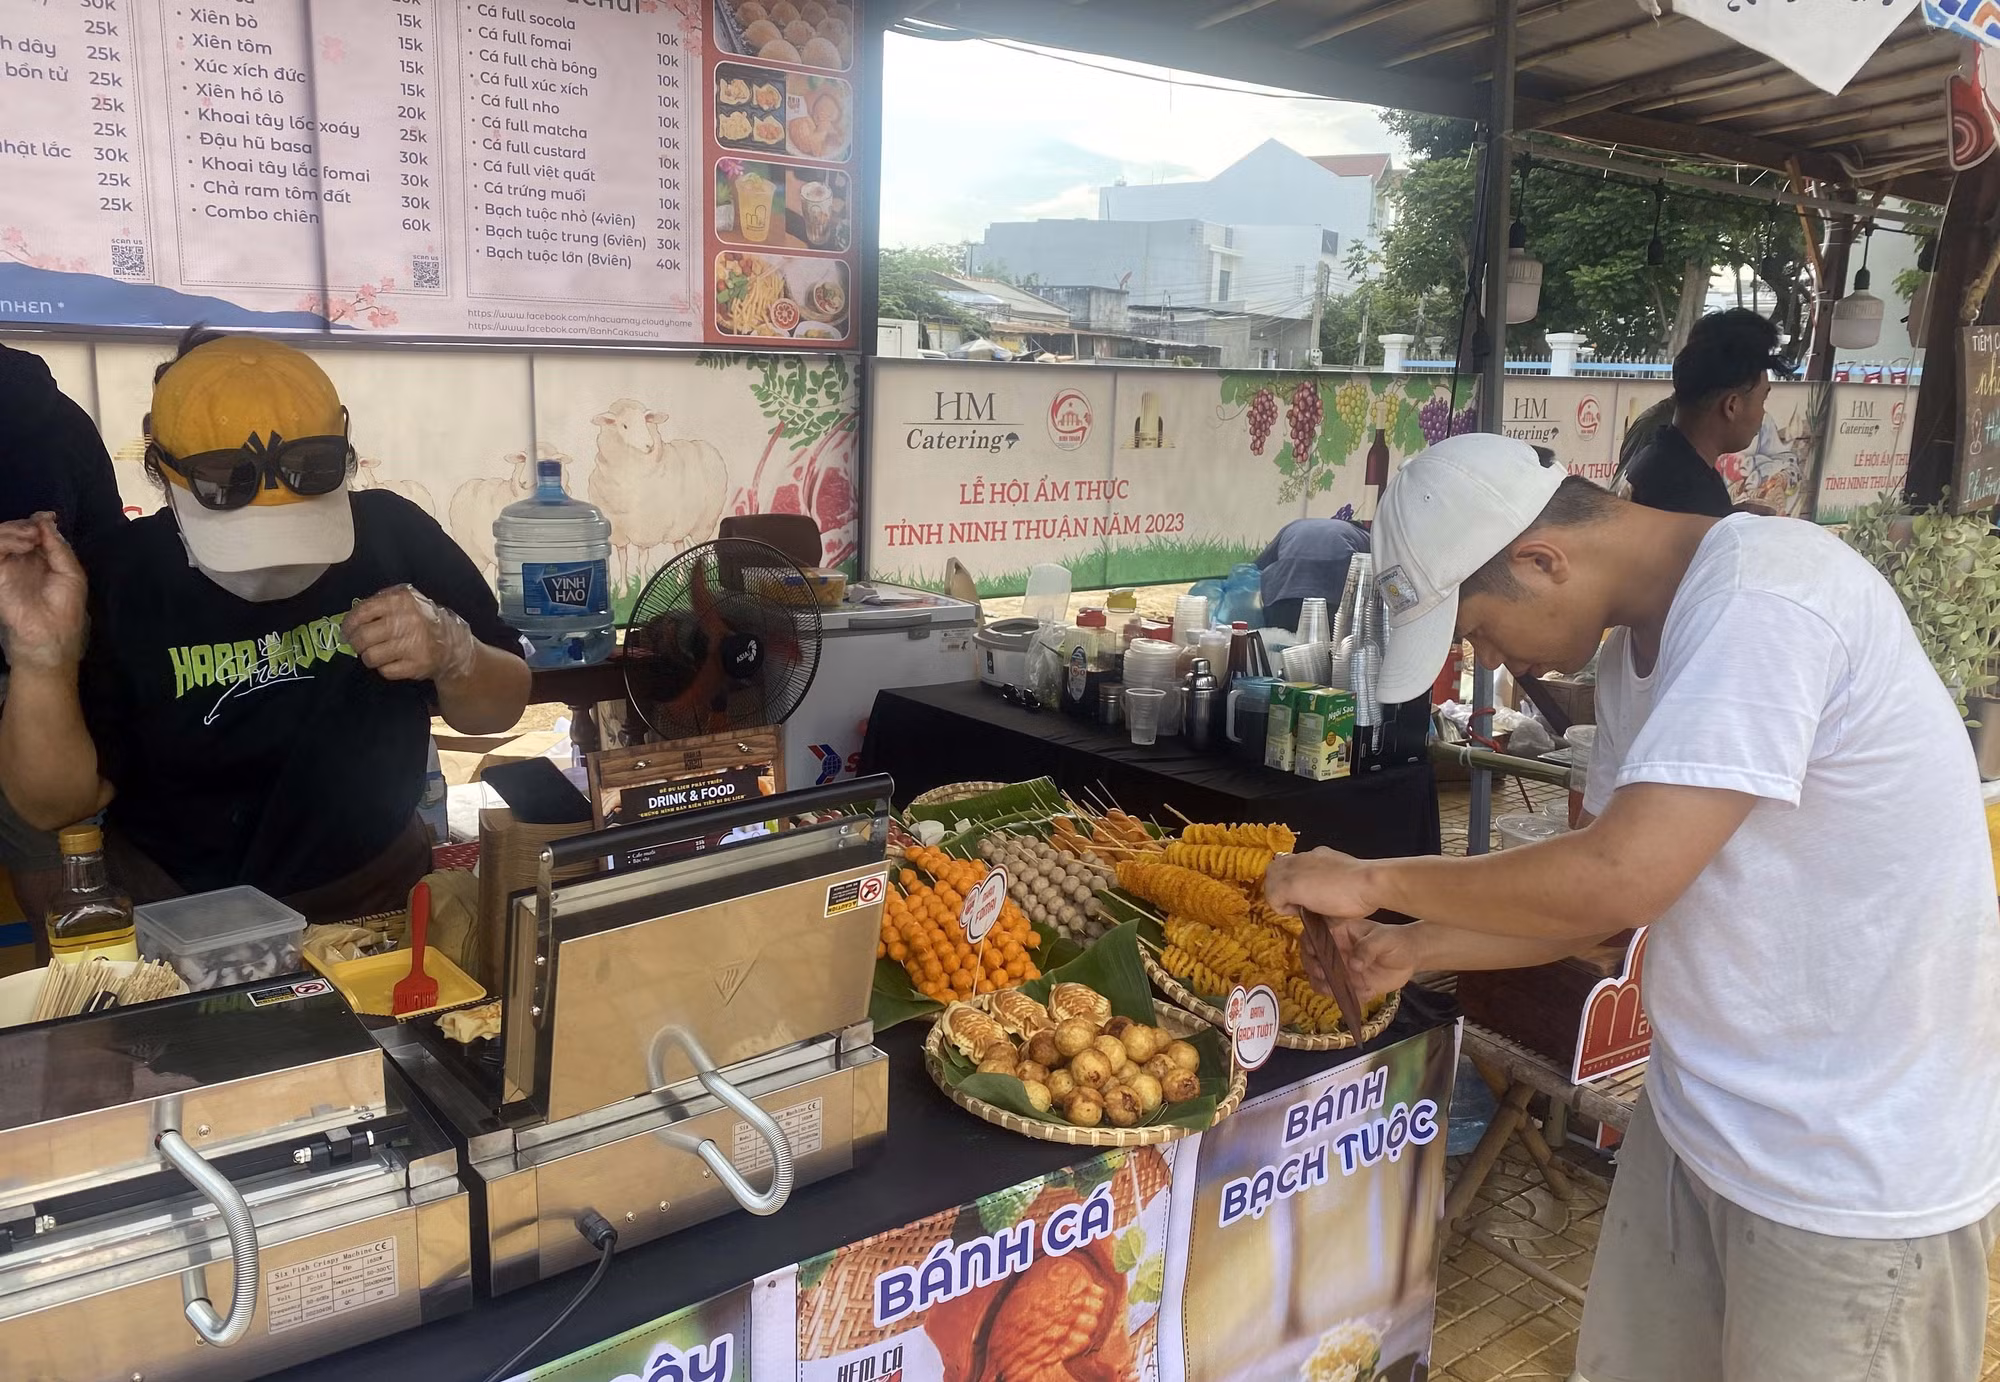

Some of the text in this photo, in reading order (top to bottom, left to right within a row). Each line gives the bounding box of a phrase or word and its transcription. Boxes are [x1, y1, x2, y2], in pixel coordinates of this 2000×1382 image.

[190, 8, 258, 29] Xiên bò
[397, 13, 422, 29] 15k
[477, 3, 575, 30] Cá full socola
[84, 20, 118, 36] 25k
[192, 33, 272, 55] Xiên tôm
[398, 36, 423, 52] 15k
[478, 26, 571, 51] Cá full fomai
[657, 32, 678, 47] 10k
[18, 38, 56, 58] dây
[87, 46, 120, 62] 25k
[399, 60, 425, 75] 15k
[479, 49, 597, 79] Cá full chà bông
[657, 53, 679, 68] 10k
[6, 62, 69, 82] bồn tử
[89, 71, 123, 87] 25k
[194, 57, 306, 83] Xúc xích đức
[401, 83, 426, 98] 15k
[480, 71, 588, 96] Cá full xúc xích
[658, 74, 679, 89] 10k
[196, 82, 284, 104] Xiên hồ lô
[658, 95, 679, 109] 10k
[91, 97, 125, 113] 25k
[397, 105, 427, 121] 20k
[481, 93, 560, 115] Cá full nho
[93, 122, 127, 138] 25k
[198, 107, 360, 139] Khoai tây lốc xoáy
[482, 116, 587, 139] Cá full matcha
[658, 116, 679, 130] 10k
[200, 132, 312, 154] Đậu hũ basa
[400, 128, 428, 143] 25k
[658, 137, 680, 150] 10k
[42, 141, 72, 159] lắc
[94, 147, 129, 163] 30k
[483, 137, 586, 159] Cá full custard
[399, 151, 429, 166] 30k
[659, 157, 680, 170] 10k
[202, 156, 370, 183] Khoai tây lắc fomai
[483, 159, 595, 182] Cá full việt quất
[98, 172, 131, 188] 25k
[400, 173, 430, 188] 30k
[659, 177, 680, 191] 10k
[203, 180, 351, 204] Chả ram tôm đất
[484, 181, 586, 202] Cá trứng muối
[100, 197, 133, 212] 25k
[401, 196, 431, 210] 30k
[659, 198, 680, 211] 10k
[205, 204, 320, 224] Combo chiên
[485, 203, 635, 230] Bạch tuộc nhỏ (4viên)
[402, 218, 431, 232] 60k
[656, 219, 680, 231] 20k
[486, 224, 646, 251] Bạch tuộc trung (6viên)
[657, 238, 680, 251] 30k
[486, 246, 632, 270] Bạch tuộc lớn (8viên)
[656, 258, 681, 271] 40k
[934, 392, 997, 421] HM
[1513, 398, 1547, 419] HM
[1851, 400, 1874, 418] HM
[1840, 421, 1875, 437] Catering
[906, 428, 1004, 453] Catering
[959, 474, 1129, 507] LỄ HỘI ẨM THỰC
[1847, 477, 1868, 490] NINH
[884, 513, 1184, 546] TỈNH NINH THUẬN NĂM 2023
[168, 640, 258, 699] HARD
[1342, 705, 1354, 715] Sao
[648, 784, 735, 809] DRINK & FOOD
[1284, 1071, 1385, 1143] BÁNH
[1222, 1104, 1435, 1222] BẠCH TUỘC
[879, 1186, 1110, 1321] BÁNH CÁ
[275, 1247, 373, 1280] Six Fish Crispy Machine
